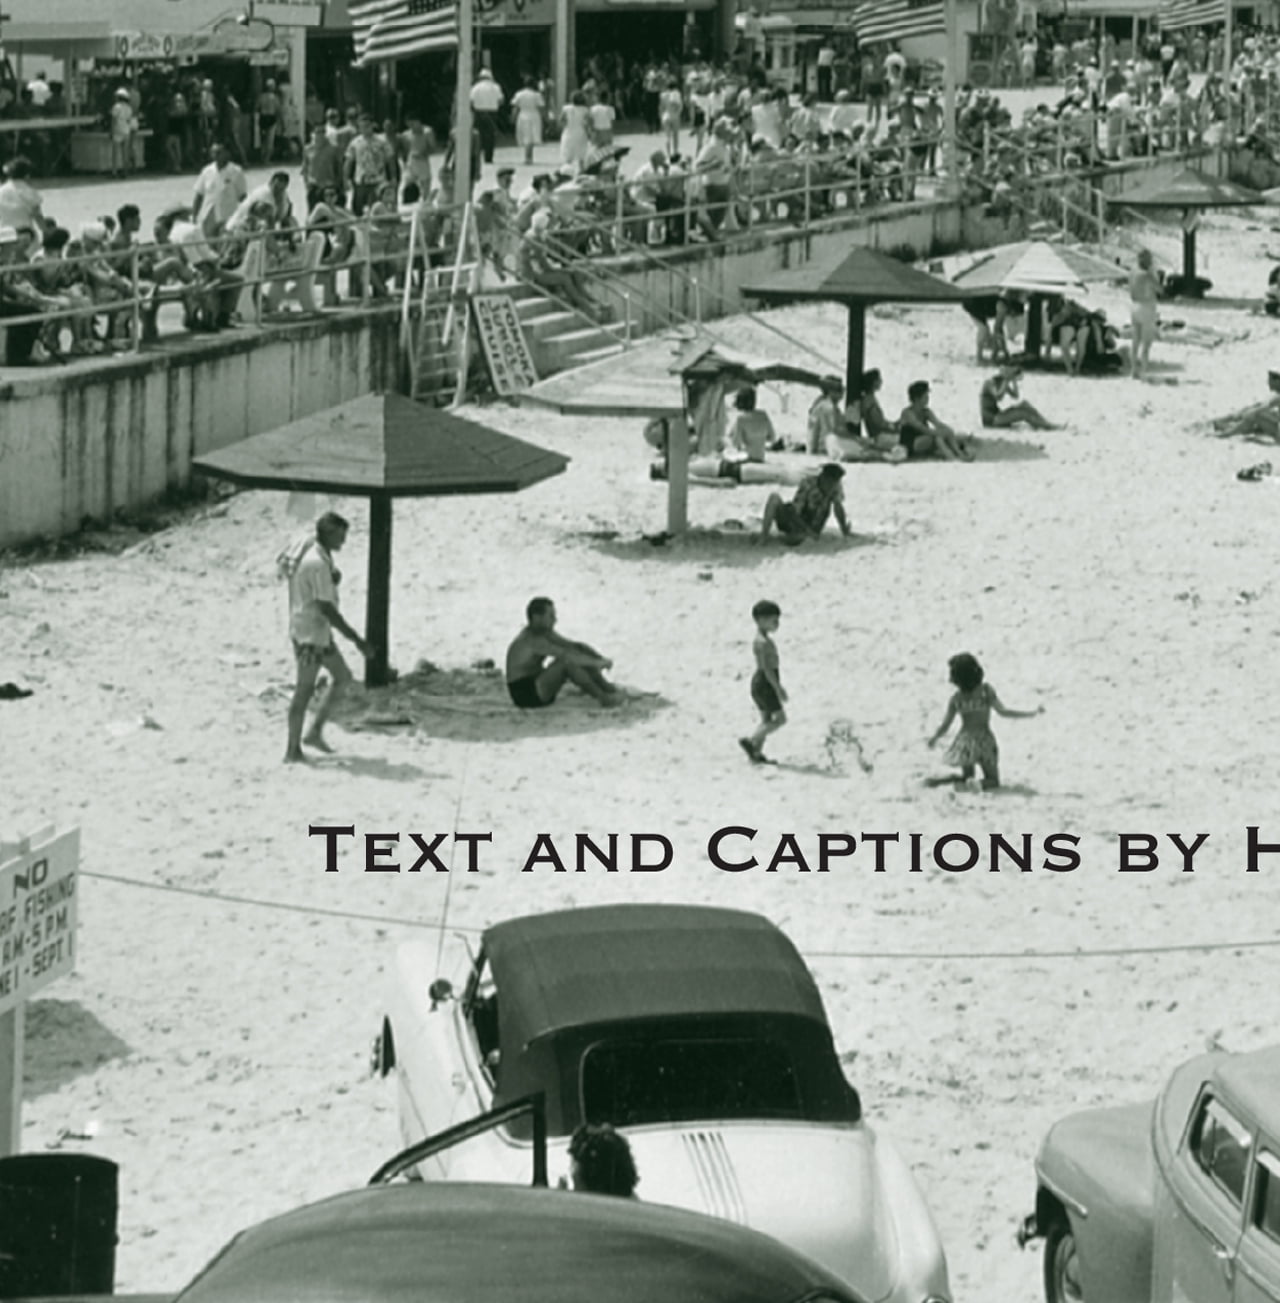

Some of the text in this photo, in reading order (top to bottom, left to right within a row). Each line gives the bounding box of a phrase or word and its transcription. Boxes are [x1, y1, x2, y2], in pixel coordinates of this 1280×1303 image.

[479, 301, 511, 391] CRUISE
[14, 858, 48, 899] NO
[25, 872, 75, 924] FISHING
[32, 936, 63, 978] SEPT
